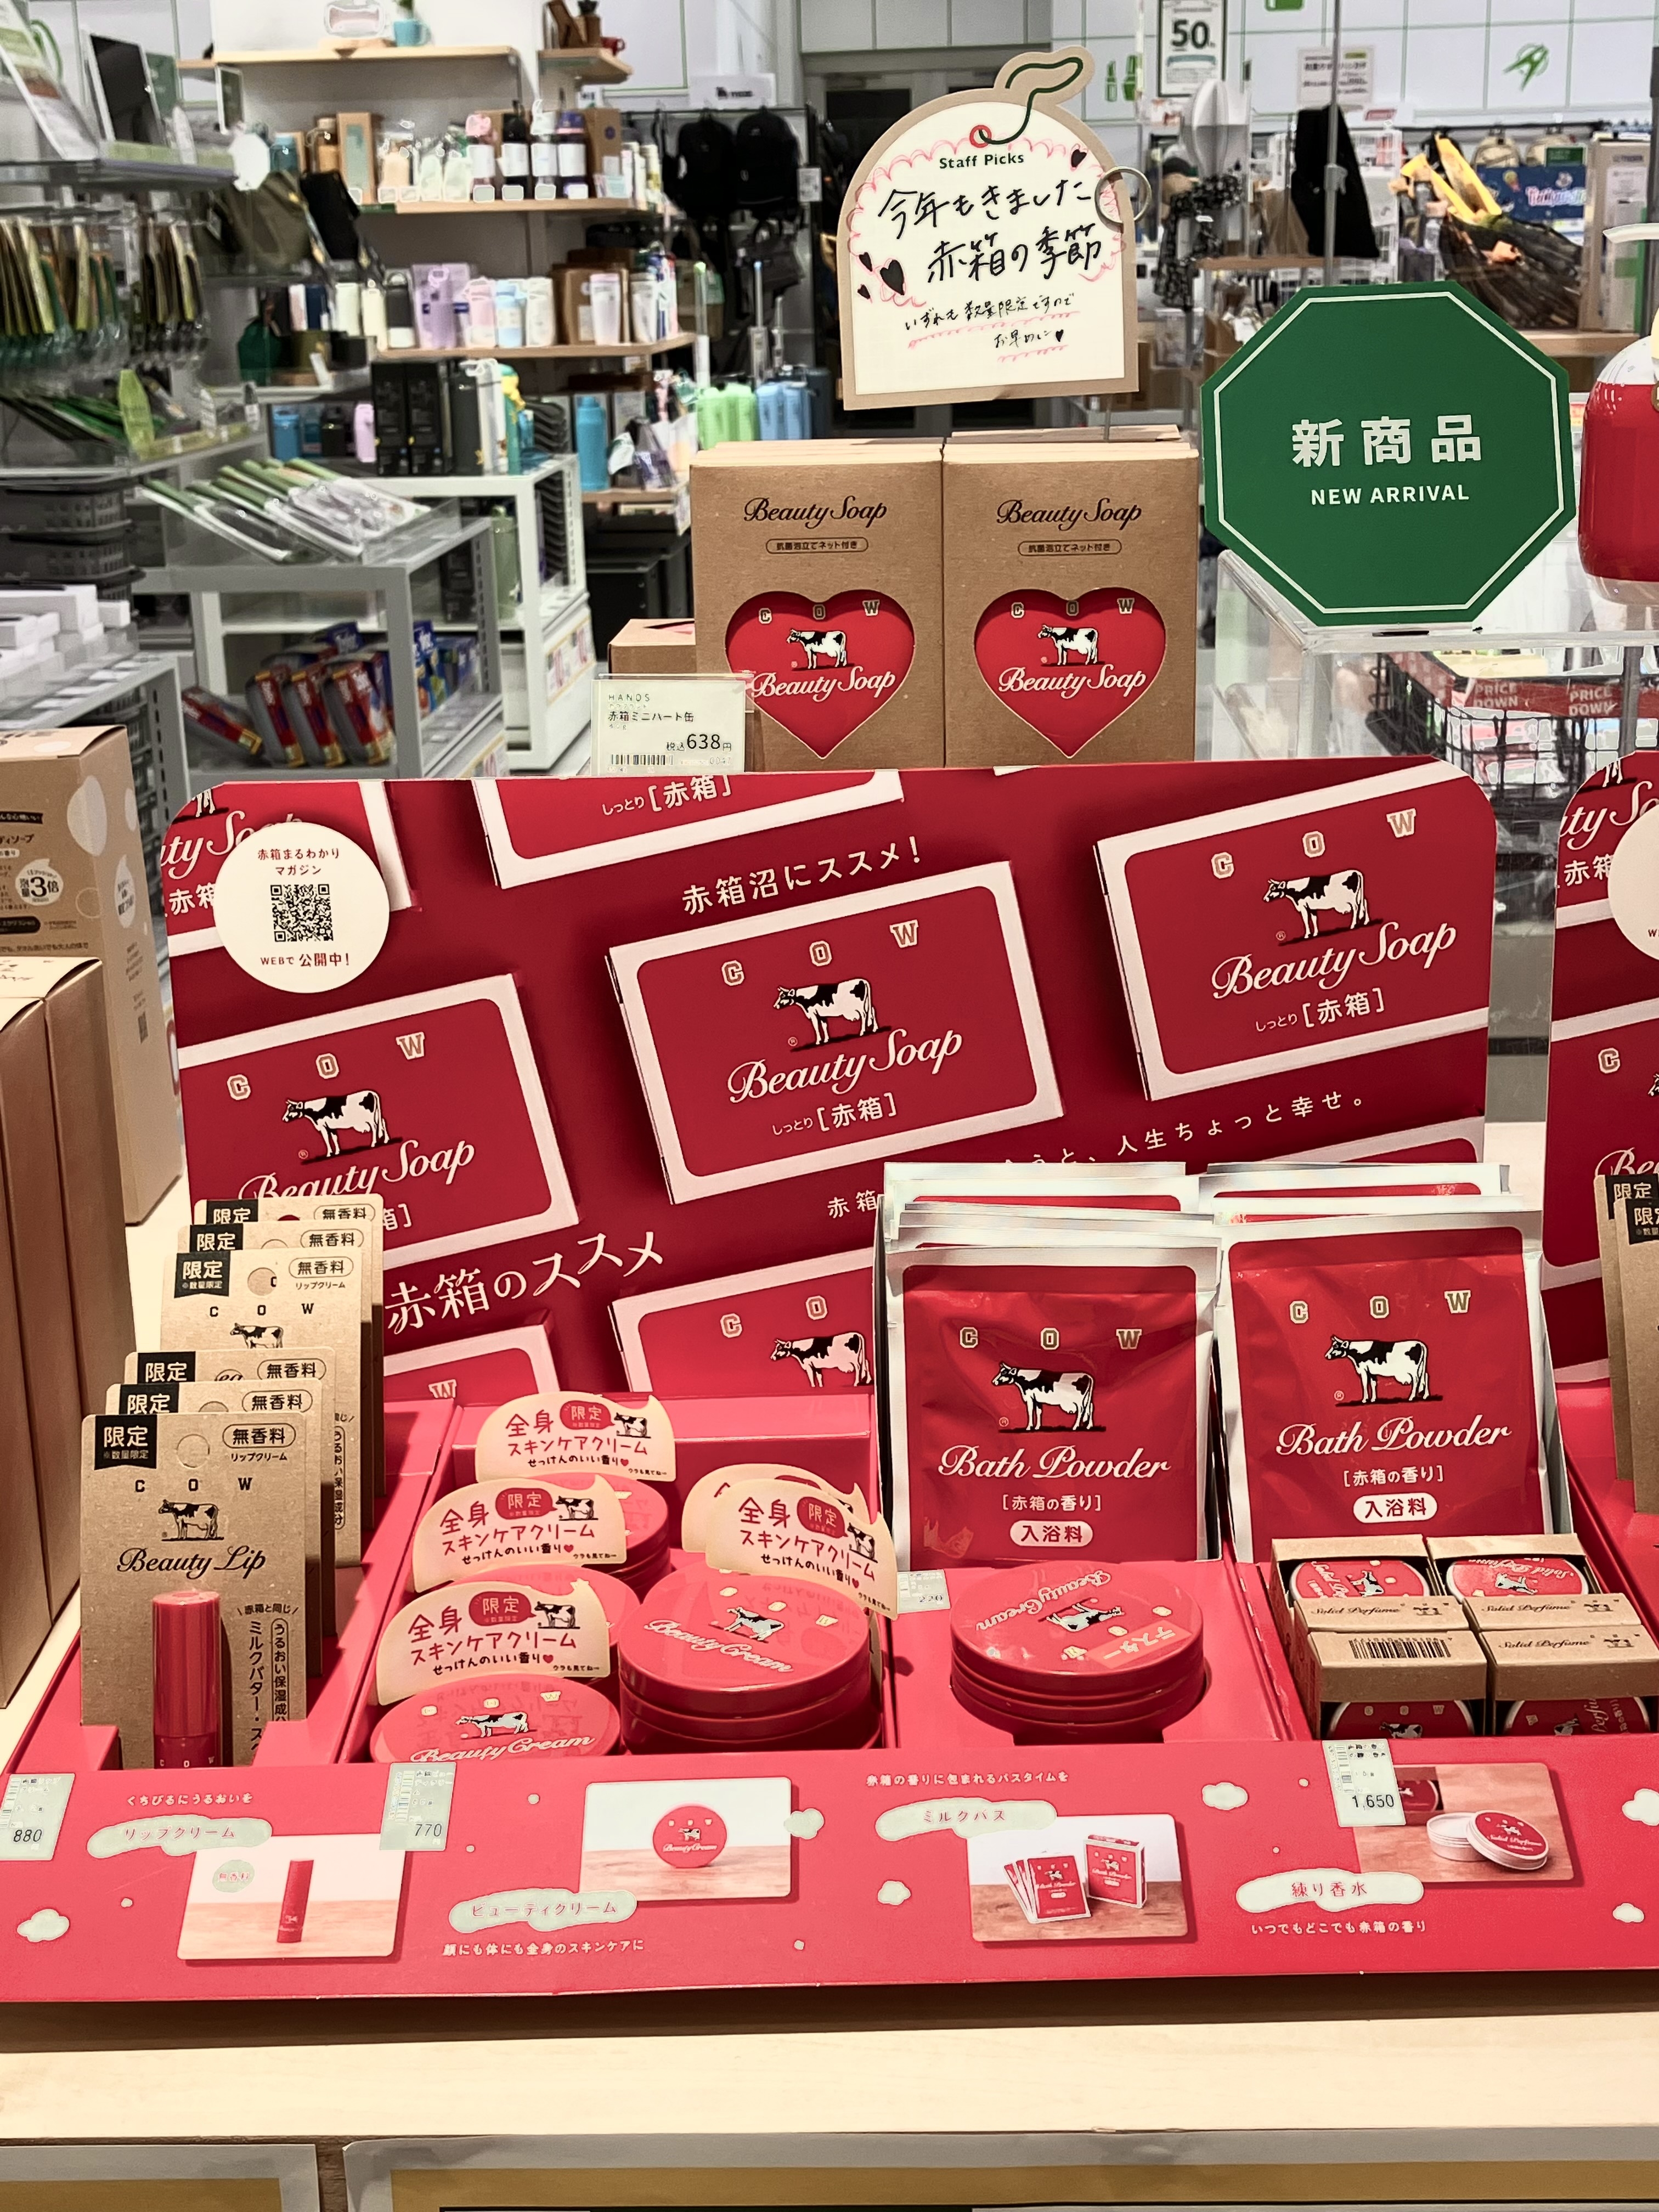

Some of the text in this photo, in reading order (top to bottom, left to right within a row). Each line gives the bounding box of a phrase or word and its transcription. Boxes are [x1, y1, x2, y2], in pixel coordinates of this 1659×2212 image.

[1171, 19, 1210, 49] 50
[939, 153, 1024, 169] Staff Picks
[878, 179, 1091, 239] 今年もきました
[928, 223, 1102, 283] 赤箱の季節
[905, 293, 1074, 330] いずれも数量限定ですので
[1291, 414, 1482, 467] 新商品
[1311, 484, 1469, 506] NEW ARRIVAL
[744, 495, 887, 529] Beauty Soap
[996, 498, 1142, 531] Beauty Soap
[751, 665, 895, 702] Beauty Soap
[998, 664, 1146, 699] Beauty Soap
[1474, 682, 1517, 695] PRICE
[608, 693, 650, 702] HANDS
[1474, 696, 1518, 708] DOWN
[1570, 686, 1613, 702] PRICE
[608, 710, 694, 722] 赤箱ミニハート缶
[1568, 702, 1612, 716] DOWN
[602, 796, 645, 816] しっとり
[258, 848, 340, 861] 赤箱まるわかり
[275, 865, 322, 876] マガジン
[1211, 921, 1457, 1000] Beauty Soap
[1255, 1013, 1299, 1033] しっとり
[726, 1027, 963, 1104] Beauty Soap
[771, 1116, 814, 1137] しっとり
[381, 1139, 475, 1185] Soap
[213, 1207, 367, 1224] 限定 無香料
[196, 1232, 355, 1251] 限定 無香料
[182, 1260, 345, 1279] 限定 無香料
[295, 1282, 346, 1290] リップクリーム
[385, 1231, 664, 1335] 赤箱のススメ
[145, 1362, 188, 1383] 限定
[267, 1362, 316, 1379] 無香料
[127, 1393, 303, 1414] 限定 無香料
[505, 1405, 602, 1437] 全身 限定
[103, 1426, 285, 1448] 限定 無香料
[1276, 1415, 1512, 1455] Bath Powder
[508, 1436, 647, 1456] スキンケアクリーム
[230, 1453, 287, 1462] リップクリーム
[938, 1444, 1172, 1479] Bath Powder
[440, 1491, 541, 1535] 全身 限定
[738, 1497, 791, 1528] 全身
[809, 1503, 837, 1527] 限定
[1365, 1497, 1427, 1519] 入浴料
[442, 1523, 595, 1556] スキンケアクリーム
[1020, 1525, 1083, 1543] 入浴料
[116, 1544, 266, 1579] Beauty Lip
[740, 1530, 875, 1582] スキンケアクリーム
[976, 1570, 1111, 1631] Beauty Cream
[408, 1596, 519, 1643] 全身 限定
[411, 1631, 576, 1666] スキンケアクリーム
[644, 1619, 794, 1673] Beauty Cream
[273, 1622, 287, 1721] うるおい保湿成
[433, 1652, 540, 1675] せっけんのいい香り
[410, 1736, 595, 1762] Beauty Cream
[126, 1792, 253, 1807] くちびるにうるおいを
[1352, 1795, 1394, 1810] 1,650
[922, 1809, 1006, 1823] ミルクバス
[13, 1829, 42, 1842] 880
[125, 1826, 236, 1841] リップクリーム
[415, 1824, 442, 1837] 770
[1291, 1881, 1368, 1898] 練り香水
[472, 1901, 618, 1917] ビューティクリーム
[1251, 1920, 1426, 1934] いつでもどこでも赤箱の香り
[442, 1938, 645, 1957] 顔にも体にも全身のスキンケアに
